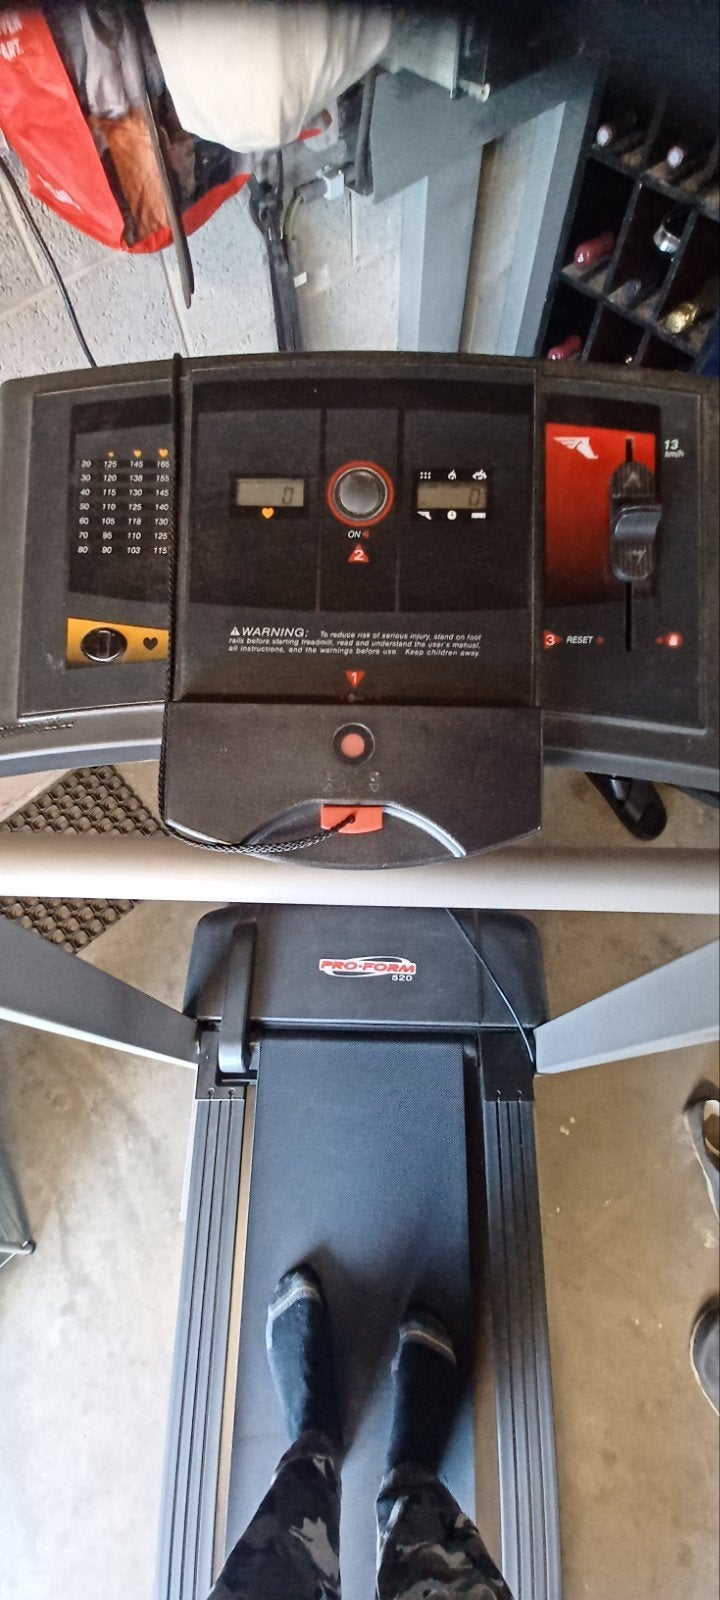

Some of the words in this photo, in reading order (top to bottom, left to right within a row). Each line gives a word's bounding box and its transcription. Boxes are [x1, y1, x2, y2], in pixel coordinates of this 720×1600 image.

[664, 439, 679, 450] 13
[81, 460, 92, 468] 20
[282, 486, 294, 504] 0
[468, 488, 481, 506] 0
[128, 518, 142, 526] 118
[127, 532, 142, 540] 110
[348, 530, 362, 538] ON
[127, 546, 141, 554] 103
[354, 550, 364, 560] 2
[242, 626, 308, 638] WARNING:
[320, 630, 328, 638] To
[545, 634, 556, 646] 3
[351, 672, 358, 684] 1
